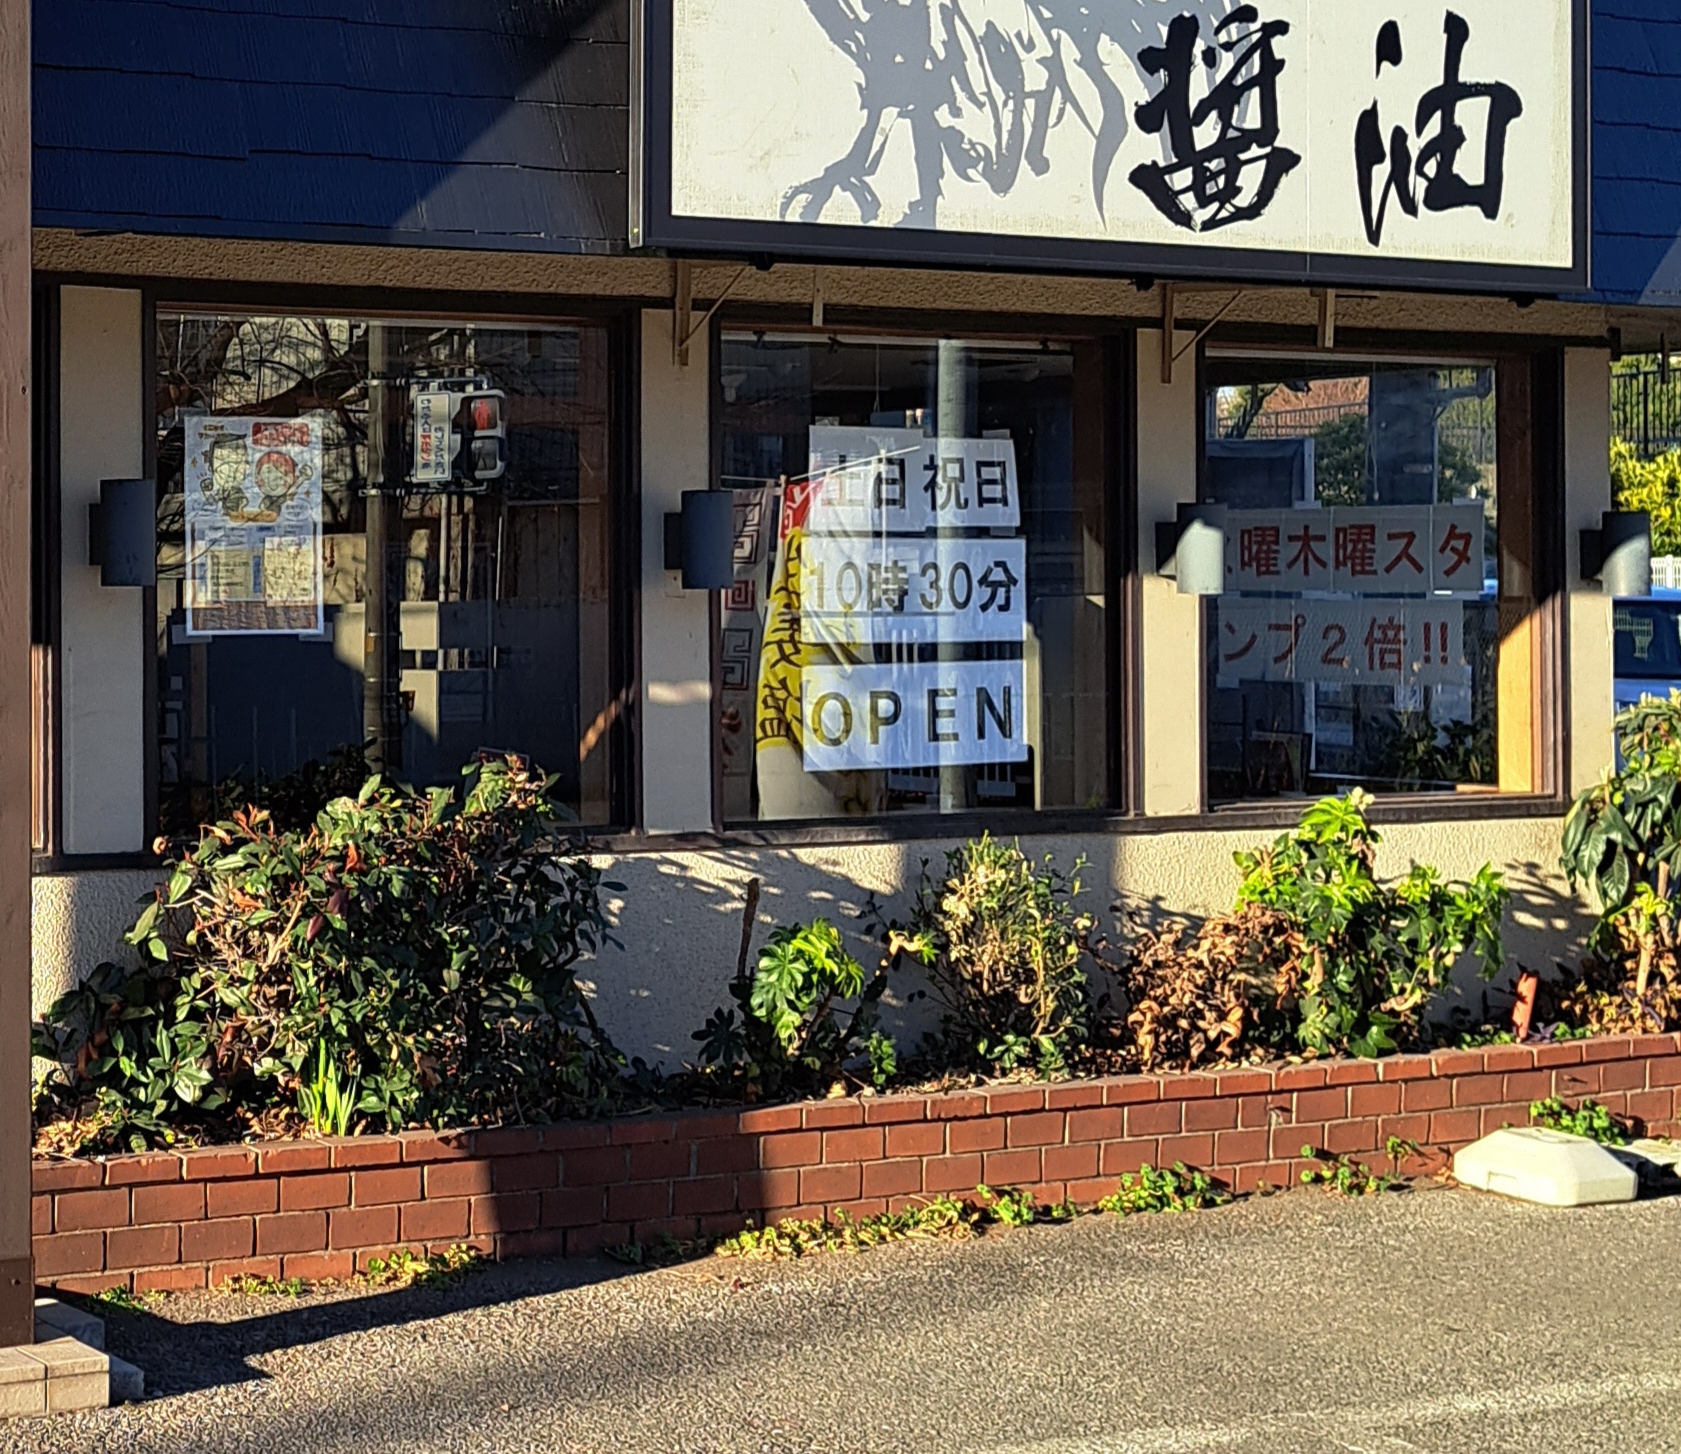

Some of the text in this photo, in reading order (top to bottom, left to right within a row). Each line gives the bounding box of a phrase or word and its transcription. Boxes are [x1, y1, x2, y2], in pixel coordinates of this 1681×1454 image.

[1126, 5, 1525, 248] 醤油
[820, 454, 1010, 513] 土日祝日
[1224, 522, 1474, 580] 曜木曜スタ
[808, 559, 1020, 615] 10時30分
[809, 684, 1014, 747] OPEN
